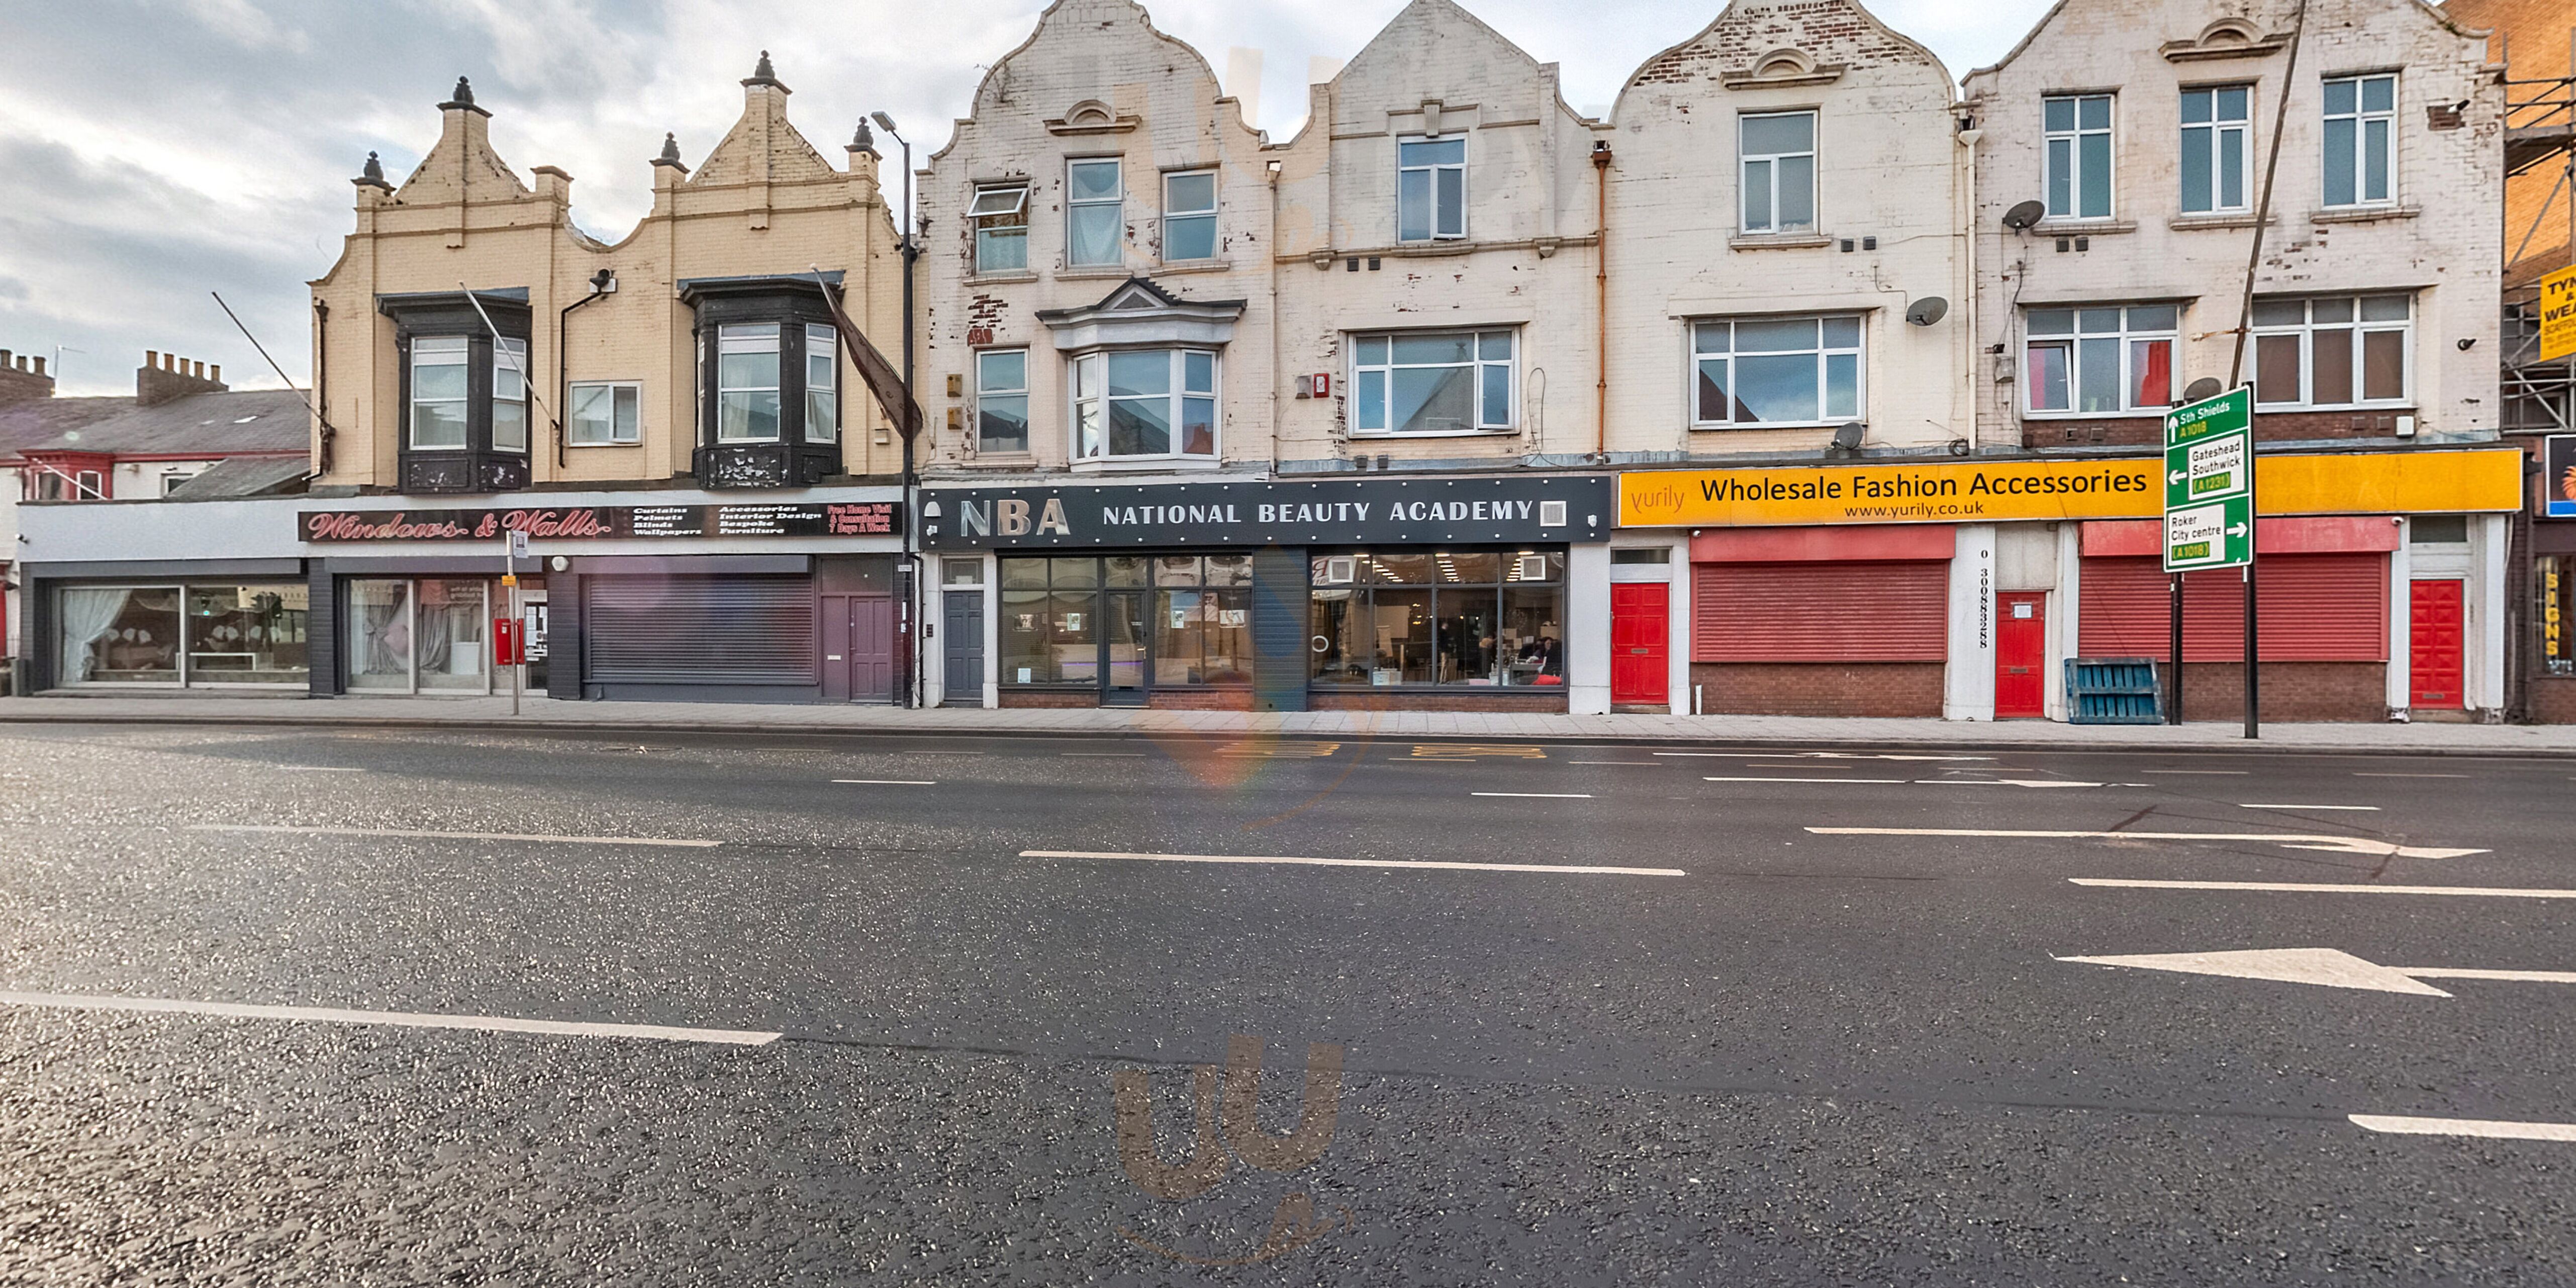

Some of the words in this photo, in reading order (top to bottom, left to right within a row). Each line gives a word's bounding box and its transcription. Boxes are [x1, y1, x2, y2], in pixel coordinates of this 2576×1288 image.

[2180, 412, 2196, 425] Sth
[2198, 401, 2230, 421] Shields
[2179, 421, 2207, 438] A1018
[2192, 441, 2240, 462] Gateshead
[2192, 455, 2241, 476] Southwick
[1701, 475, 1842, 502] Wholesale
[1853, 473, 1956, 499] Fashion
[1969, 469, 2147, 496] Accessories
[2192, 472, 2230, 495] (A1231)
[827, 505, 846, 514] Free
[846, 505, 872, 514] Home
[872, 504, 892, 513] Visit
[1631, 484, 1685, 514] yurily
[838, 514, 890, 523] Consultation
[961, 498, 1071, 537] NBA
[1103, 504, 1242, 525] NATIONAL
[1258, 502, 1370, 523] BEAUTY
[1389, 501, 1533, 522] ACADEMY
[1845, 502, 1984, 519] www.yurily.co.uk
[2172, 515, 2197, 527] Roker
[308, 513, 469, 540] Windows
[474, 513, 498, 537] &
[502, 510, 611, 537] Walls
[837, 523, 858, 534] Days
[858, 523, 866, 532] A
[867, 523, 891, 533] Week
[2171, 527, 2189, 542] City
[2192, 524, 2221, 539] centre
[2172, 542, 2210, 561] (A1018)
[2545, 572, 2560, 655] SIGNS
